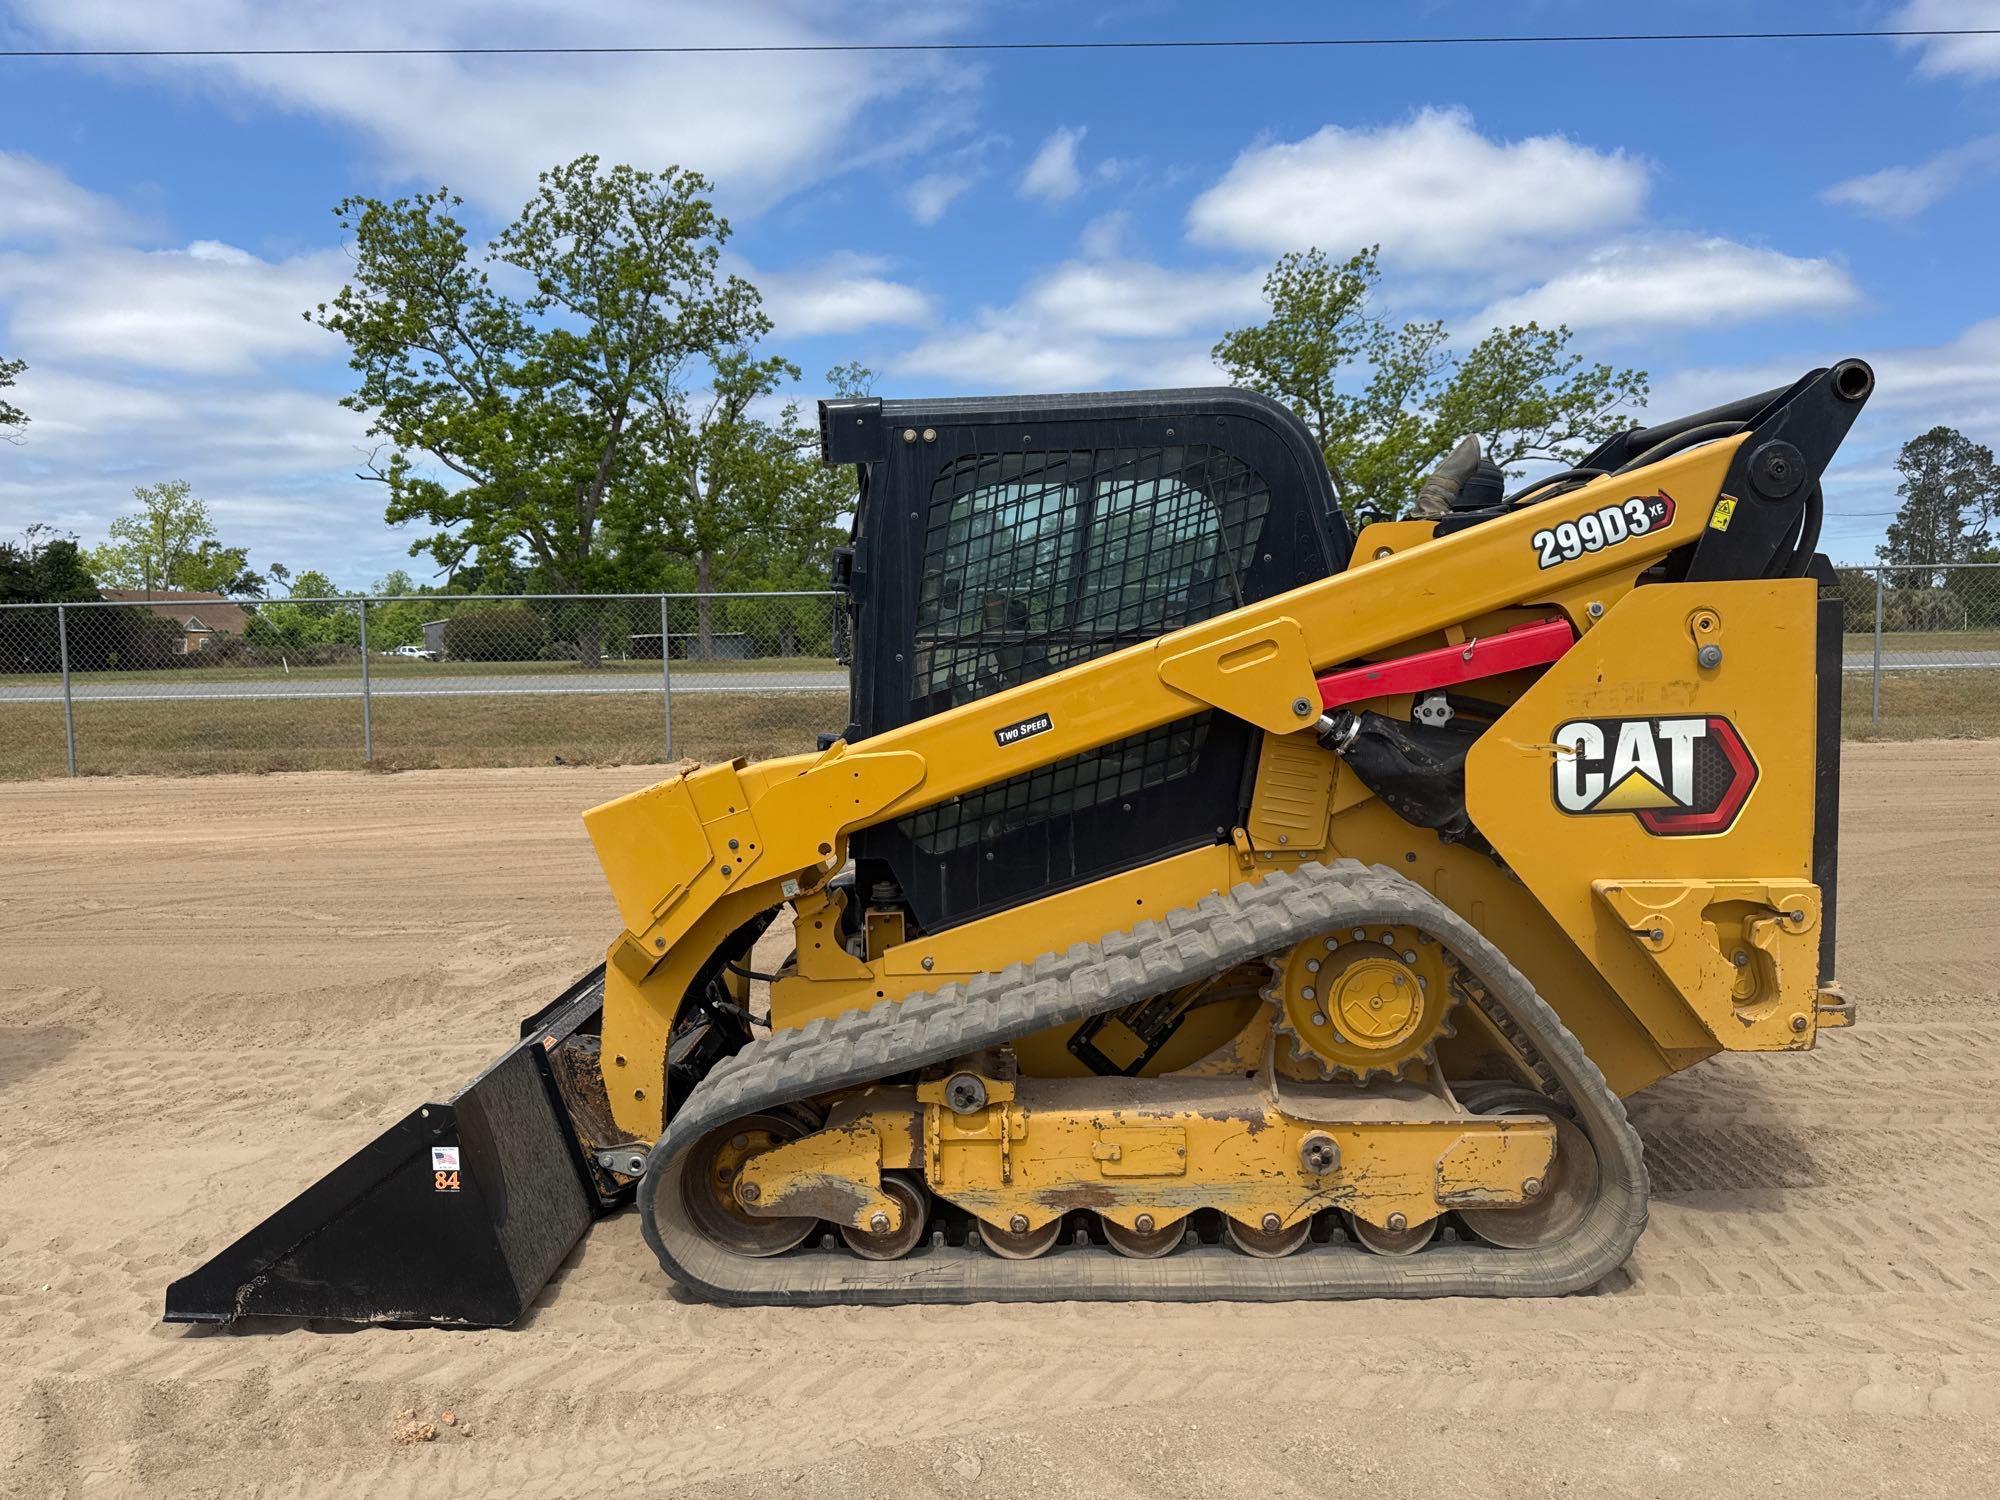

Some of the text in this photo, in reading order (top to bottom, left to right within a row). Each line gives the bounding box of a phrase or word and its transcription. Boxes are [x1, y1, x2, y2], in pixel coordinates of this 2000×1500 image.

[1533, 498, 1665, 569] 299D3 XE
[1556, 718, 1707, 811] CAT
[435, 1170, 461, 1190] 84
